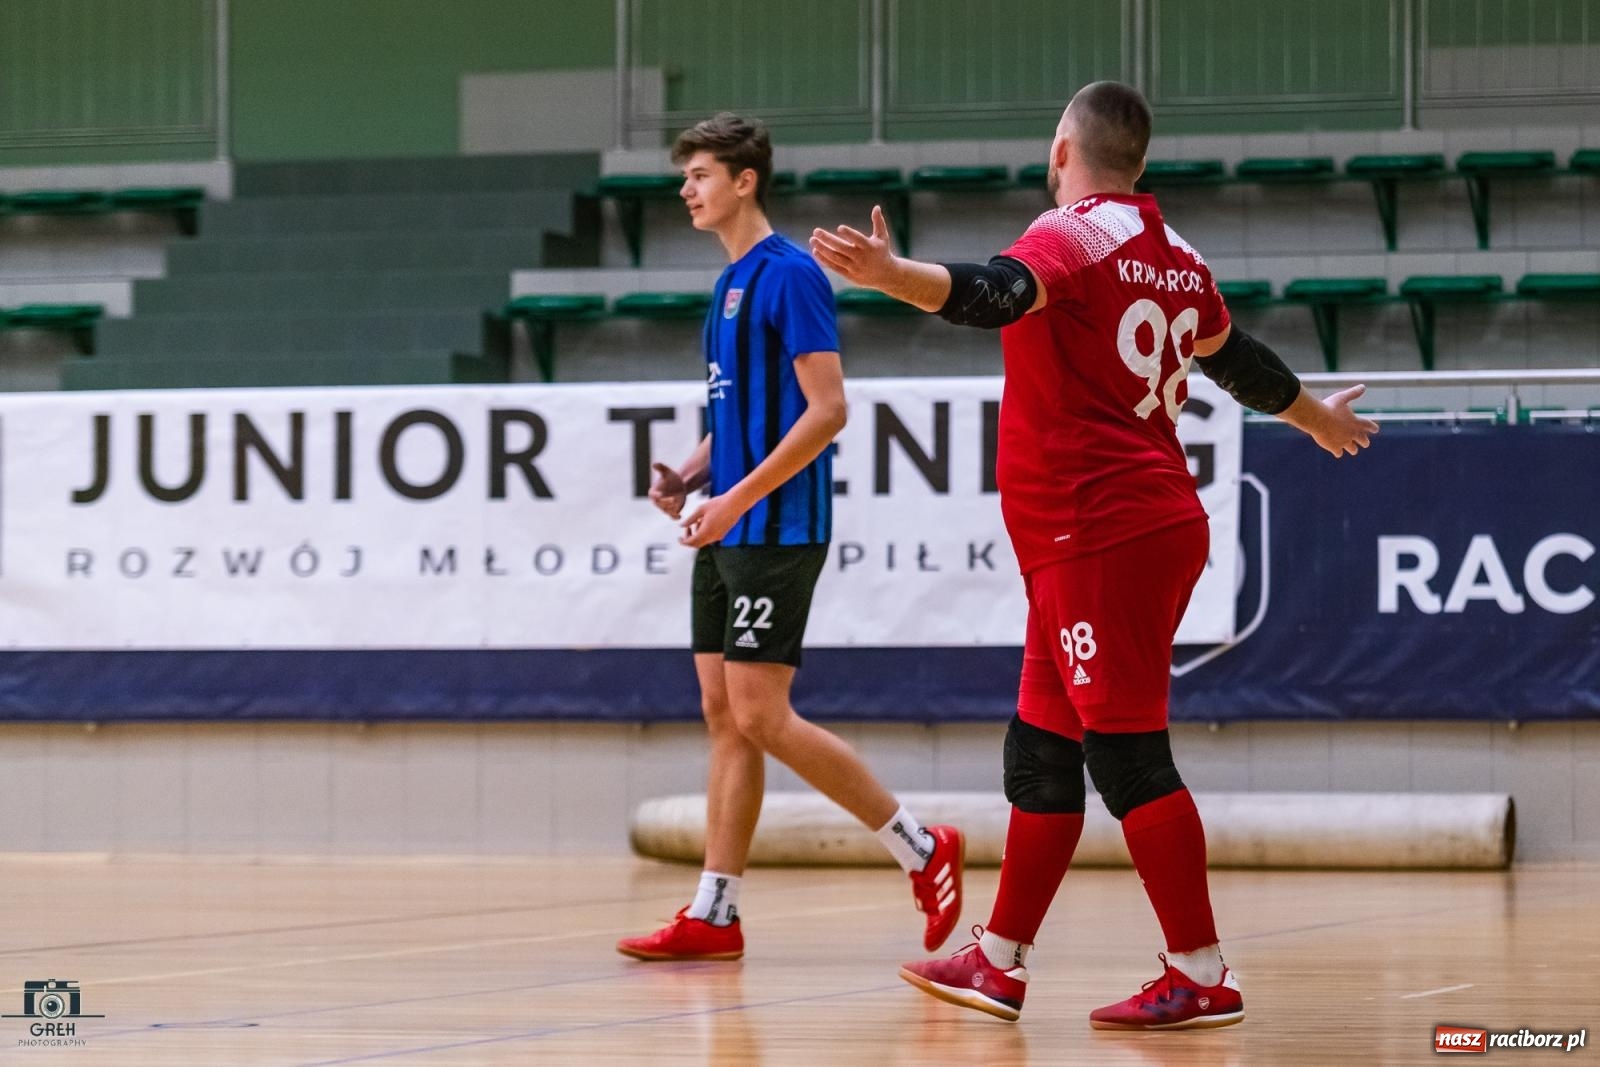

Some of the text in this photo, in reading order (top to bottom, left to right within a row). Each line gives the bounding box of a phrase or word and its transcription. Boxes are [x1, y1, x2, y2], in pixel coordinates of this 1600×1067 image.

[1116, 298, 1199, 427] 98
[71, 408, 555, 504] JUNIOR
[66, 541, 364, 579] ROZWÓJ
[419, 543, 671, 577] MŁODE
[1377, 532, 1596, 615] RAC
[733, 595, 775, 629] 22
[1060, 621, 1097, 667] 98
